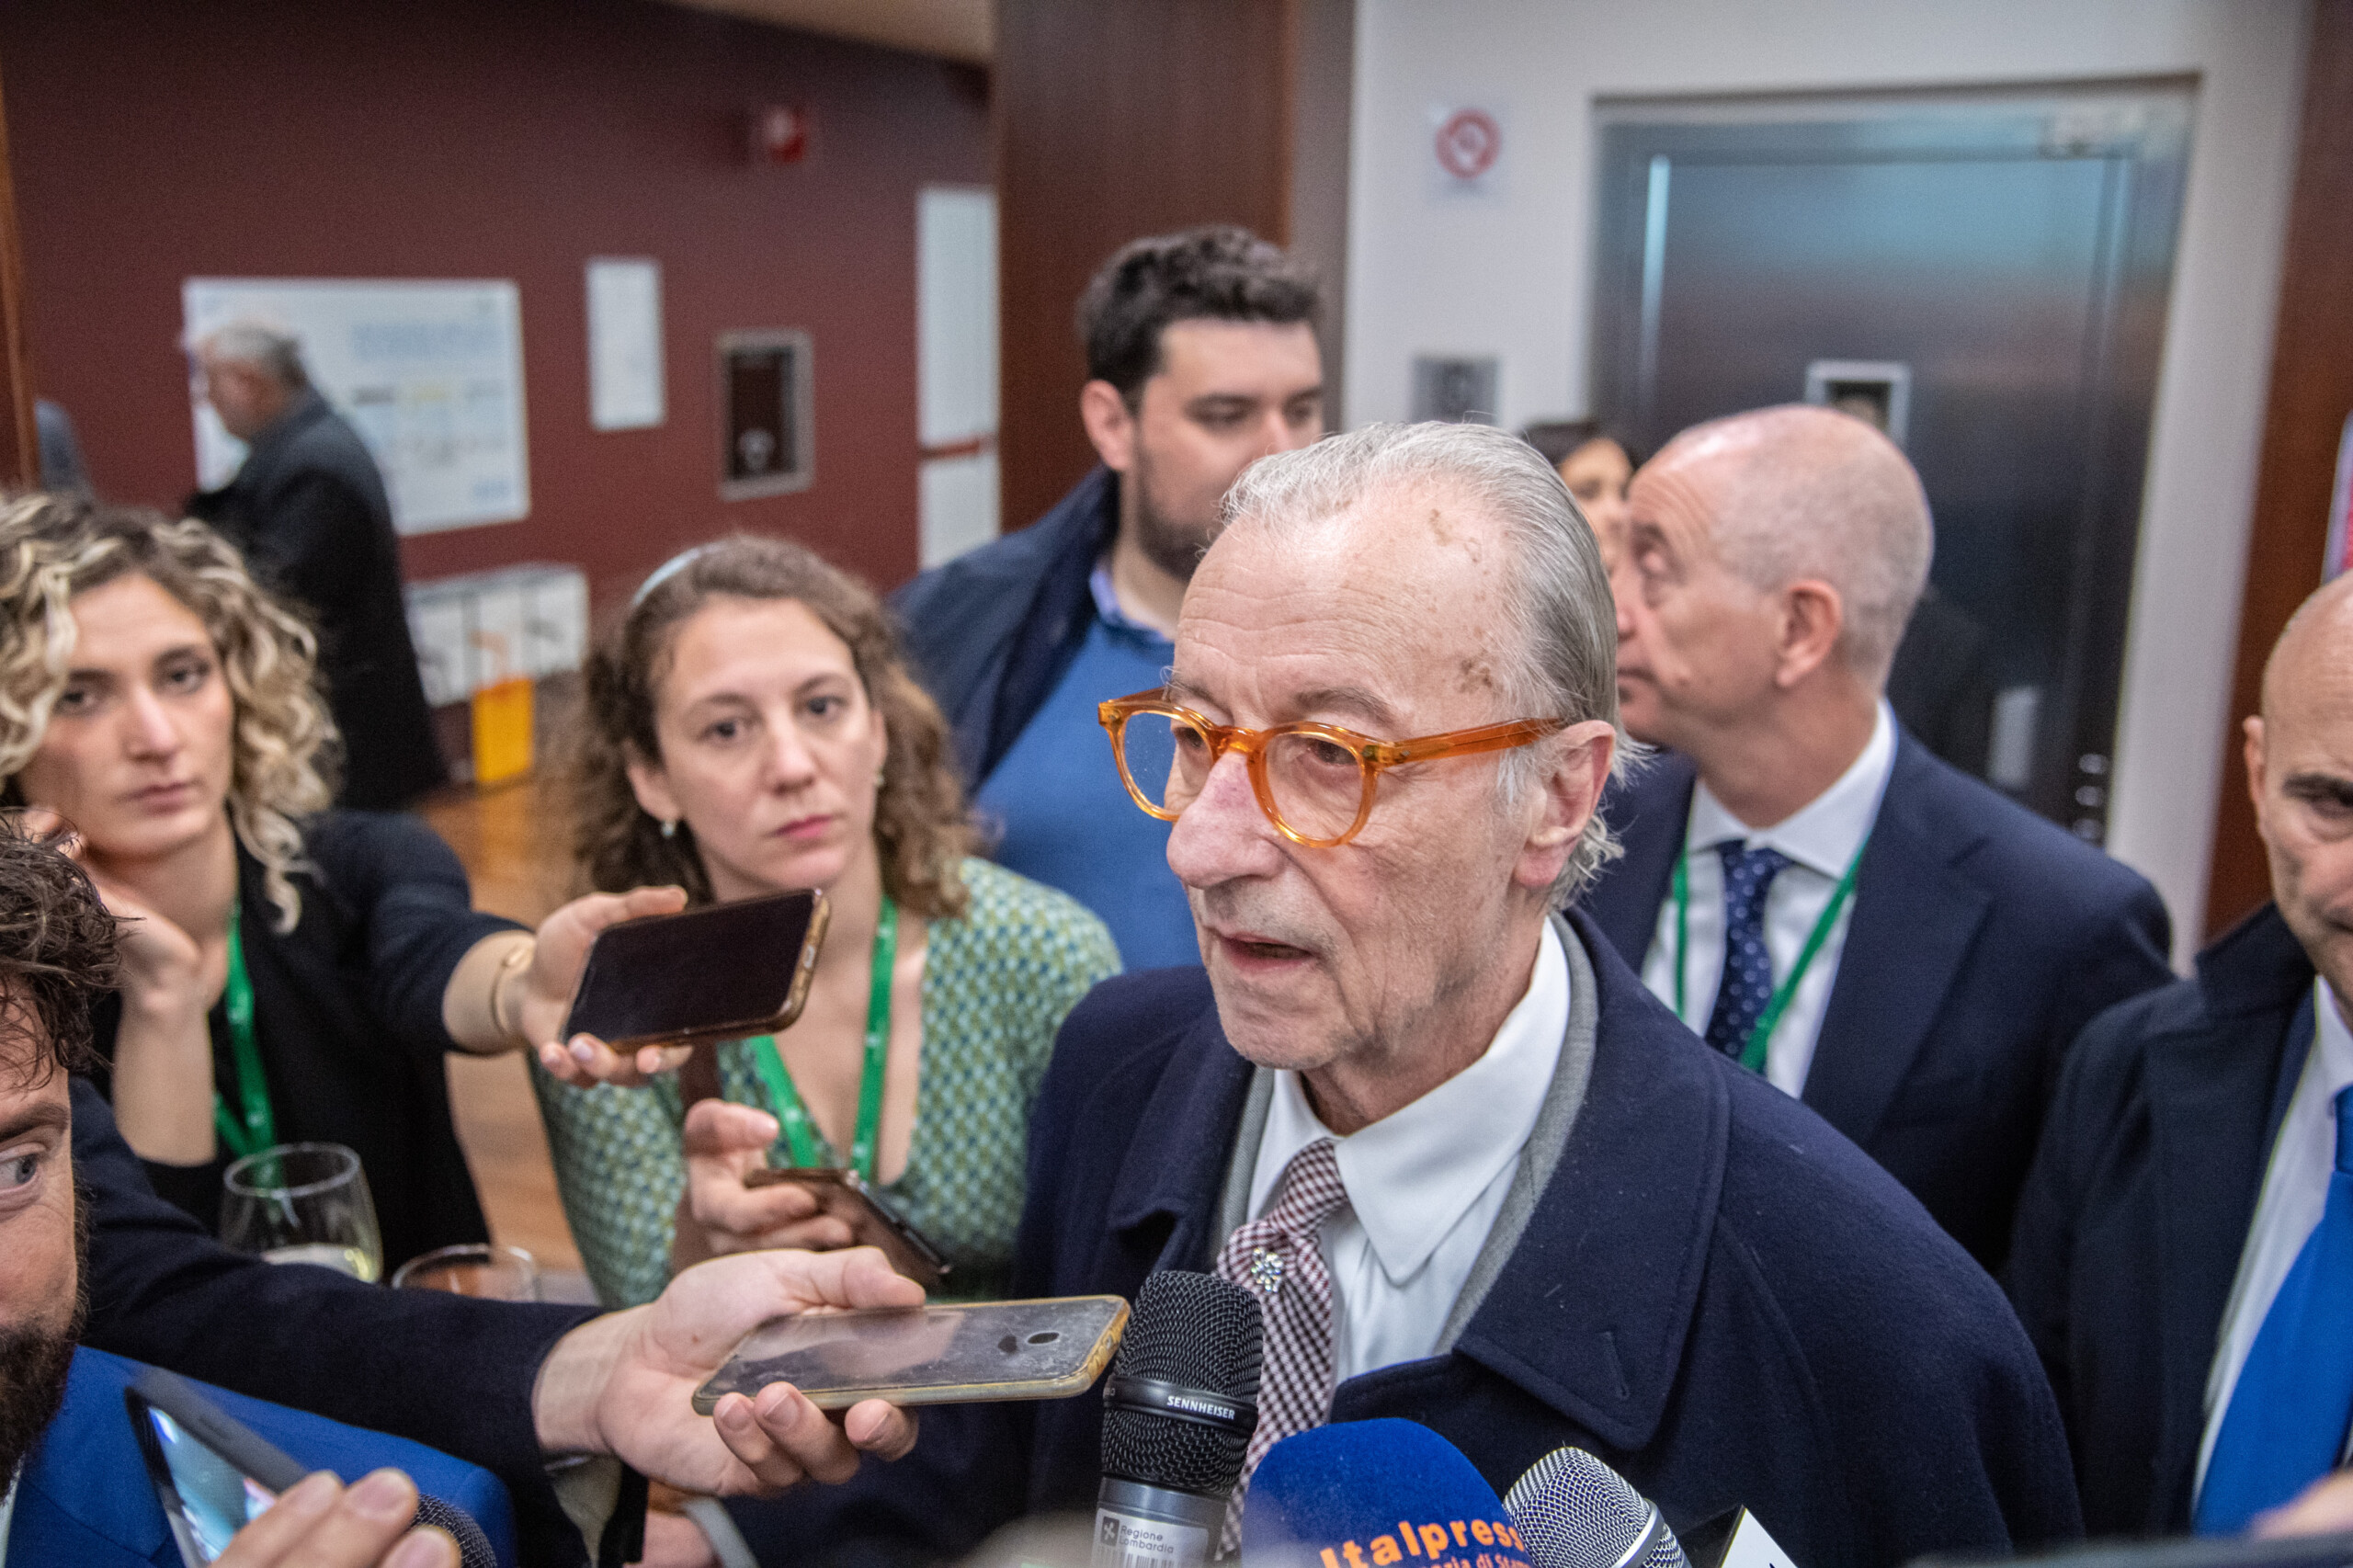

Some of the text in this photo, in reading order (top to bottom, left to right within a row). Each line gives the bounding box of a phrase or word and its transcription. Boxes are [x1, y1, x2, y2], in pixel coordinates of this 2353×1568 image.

[1166, 1395, 1235, 1420] SENNHEISER
[1120, 1525, 1164, 1541] Regione
[1320, 1518, 1525, 1568] Italpress
[1120, 1535, 1175, 1554] Lombardia
